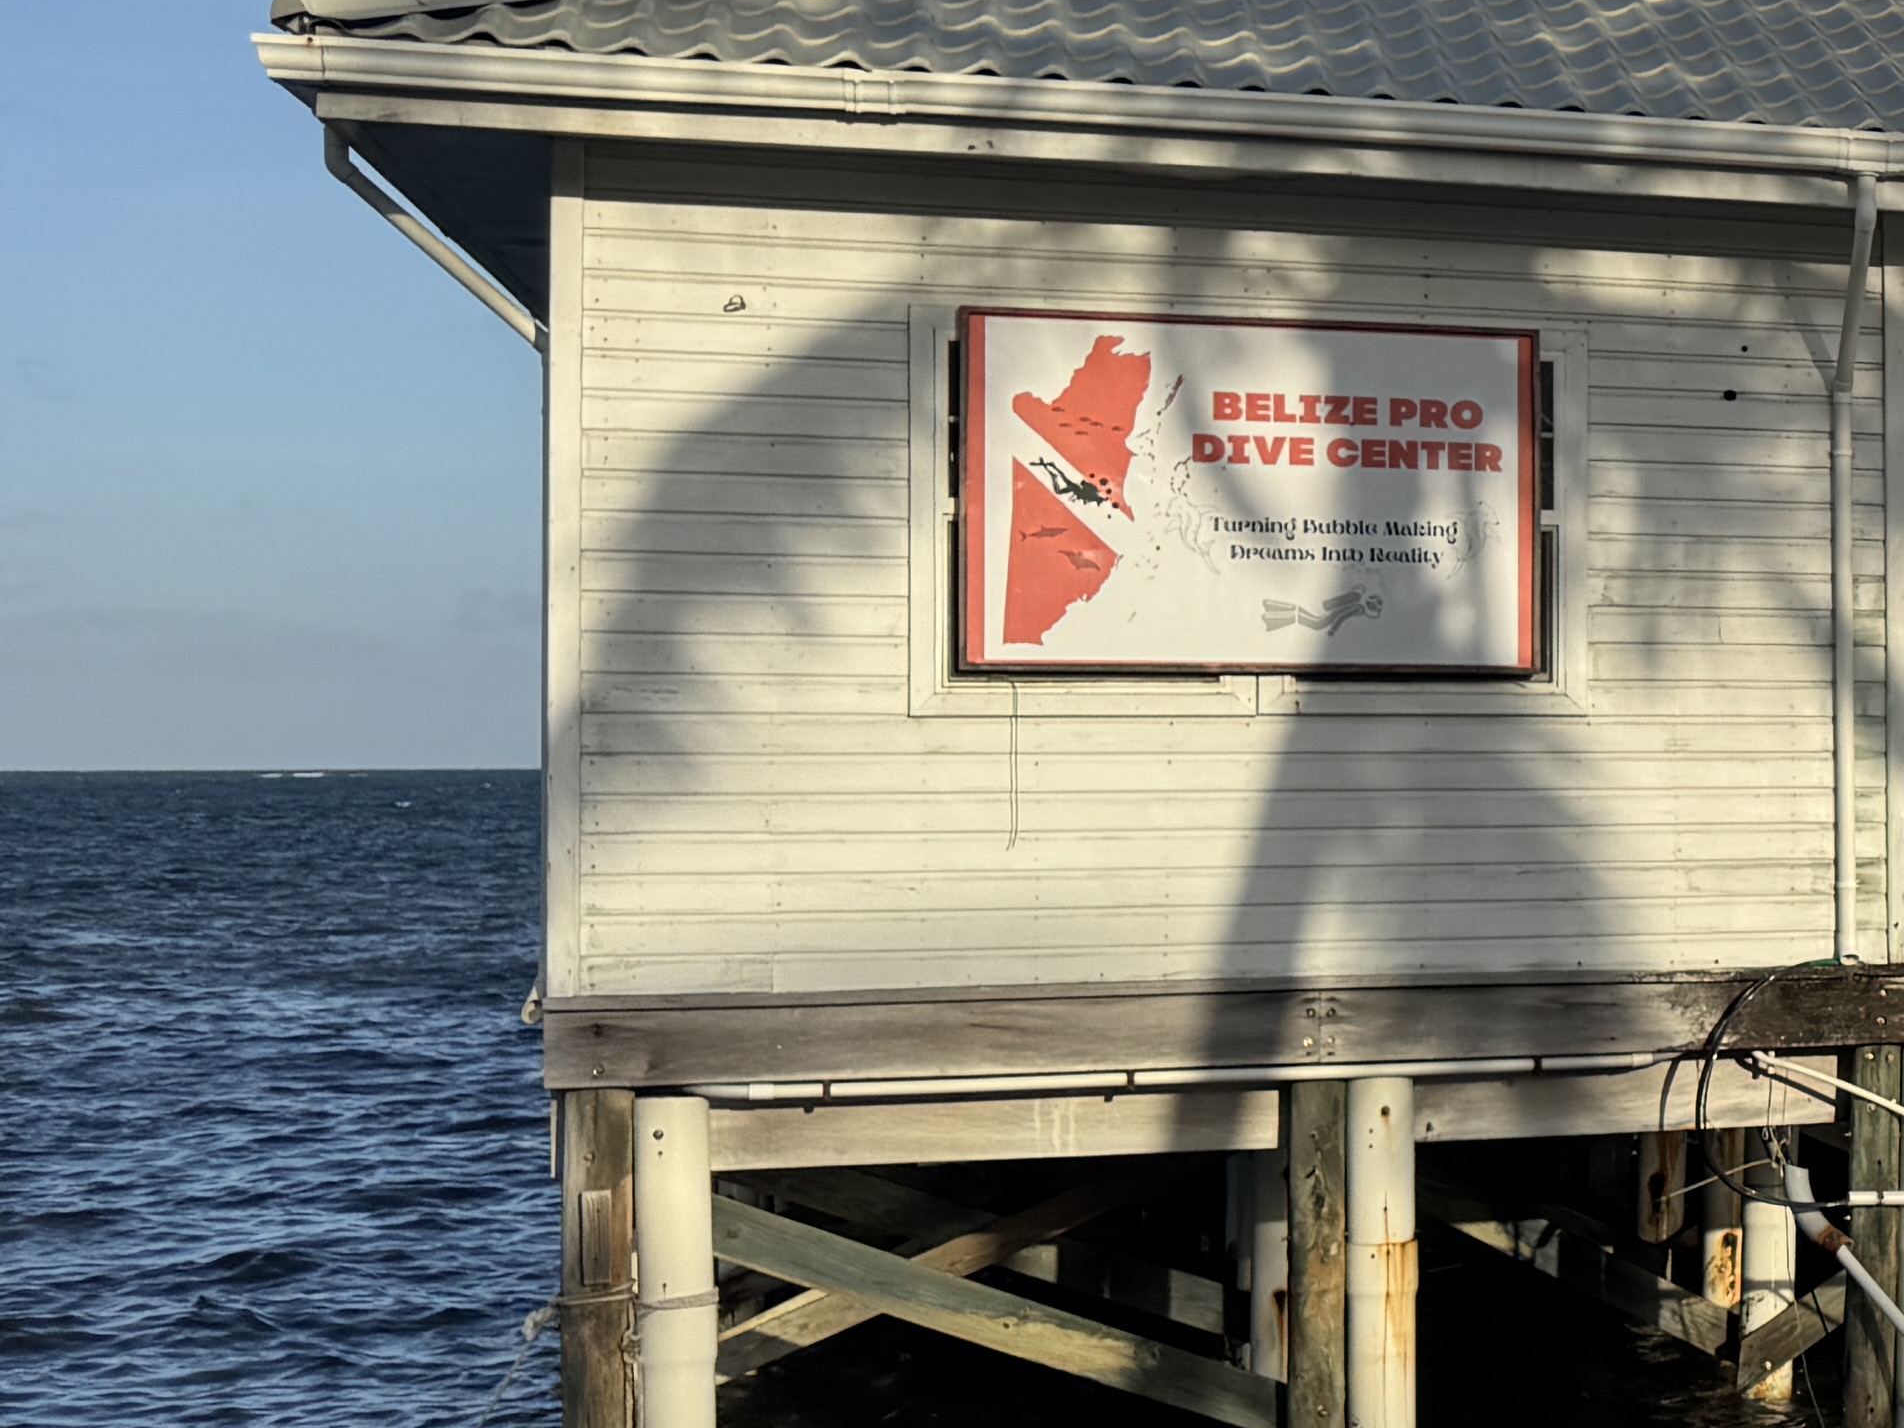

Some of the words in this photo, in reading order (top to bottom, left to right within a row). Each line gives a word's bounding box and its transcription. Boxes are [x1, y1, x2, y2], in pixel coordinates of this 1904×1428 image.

[1212, 390, 1378, 426] BELIZE
[1389, 397, 1484, 430] PRO
[1191, 433, 1315, 466] DIVE
[1326, 437, 1503, 473] CENTER
[1210, 517, 1297, 541] Turning
[1302, 518, 1378, 537] Bubble
[1383, 520, 1458, 545] Making
[1230, 544, 1316, 562] Dreams
[1321, 546, 1364, 563] Into
[1369, 547, 1444, 570] Reality
